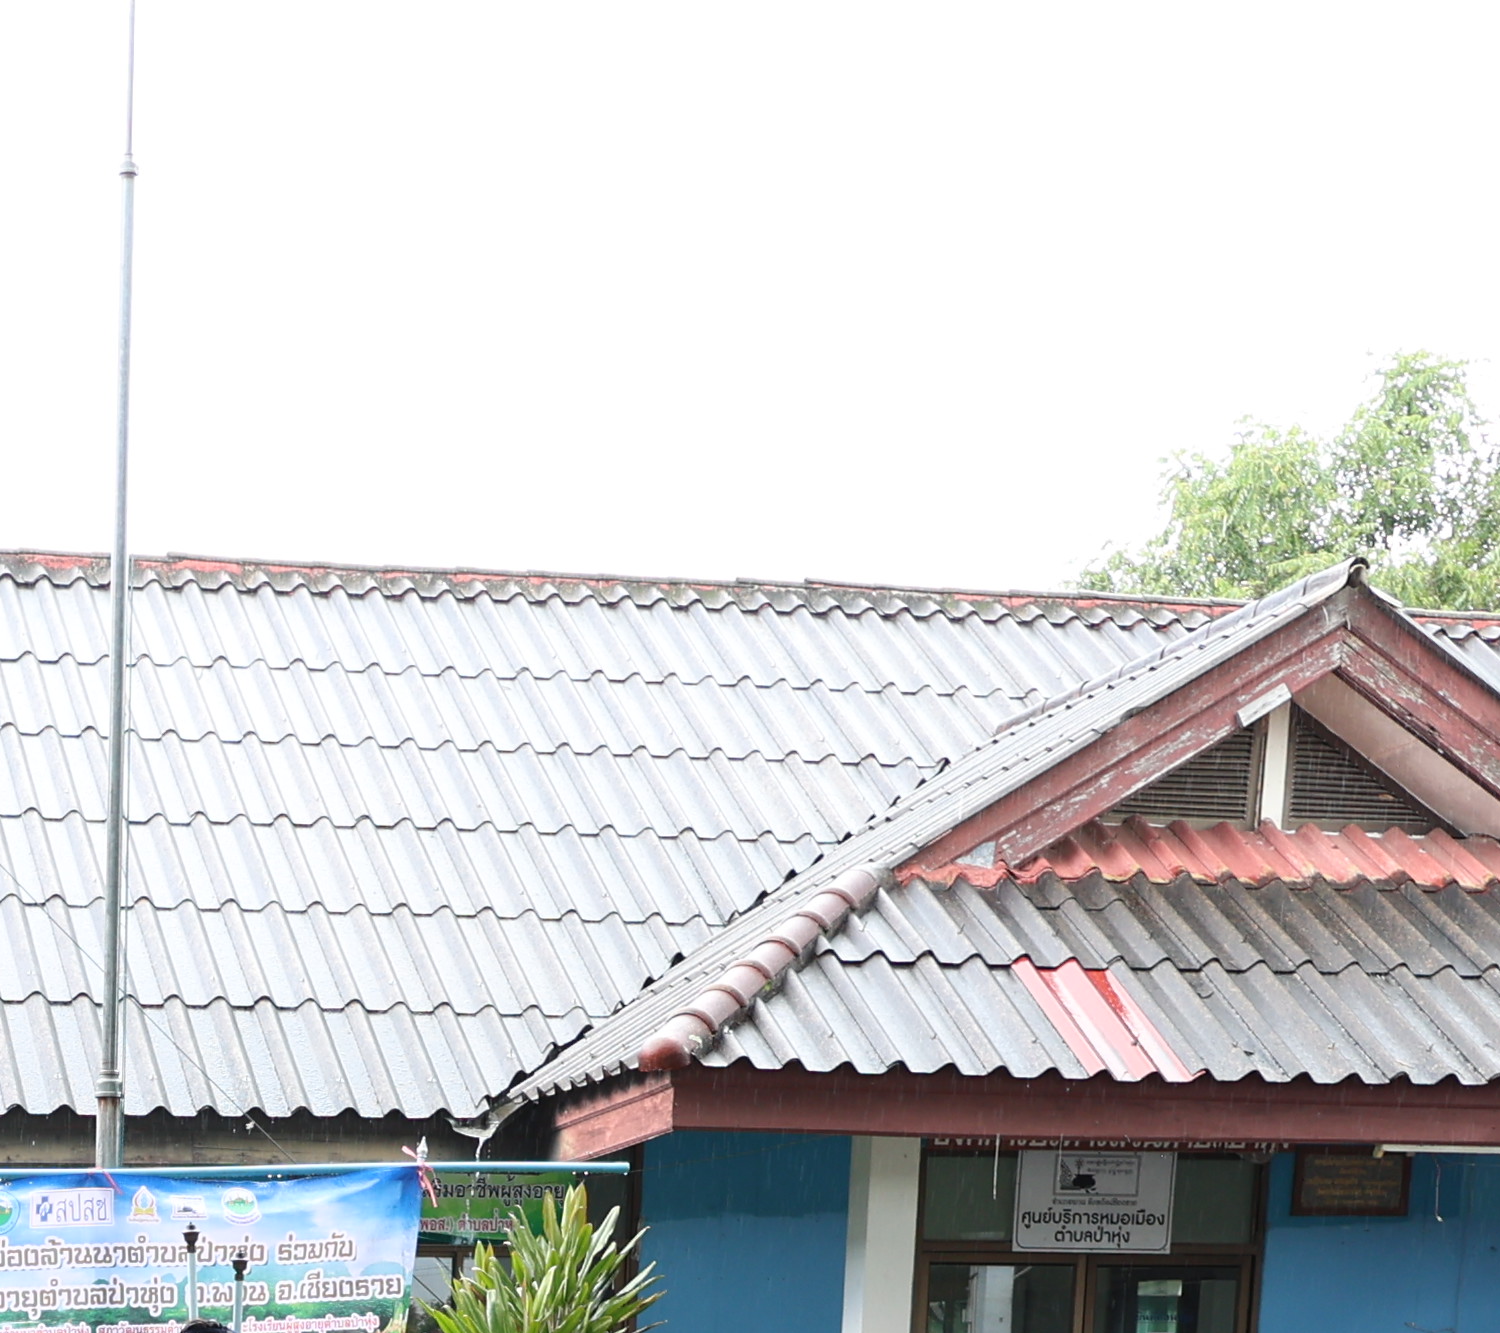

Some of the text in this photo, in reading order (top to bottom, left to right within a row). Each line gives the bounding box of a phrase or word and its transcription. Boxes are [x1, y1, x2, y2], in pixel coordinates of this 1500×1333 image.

[1021, 1207, 1165, 1230] ศูนย์บริการหมอเมือง
[277, 1233, 355, 1261] ร่วมกับ
[1054, 1227, 1131, 1249] ตำบลป่าหุ่ง
